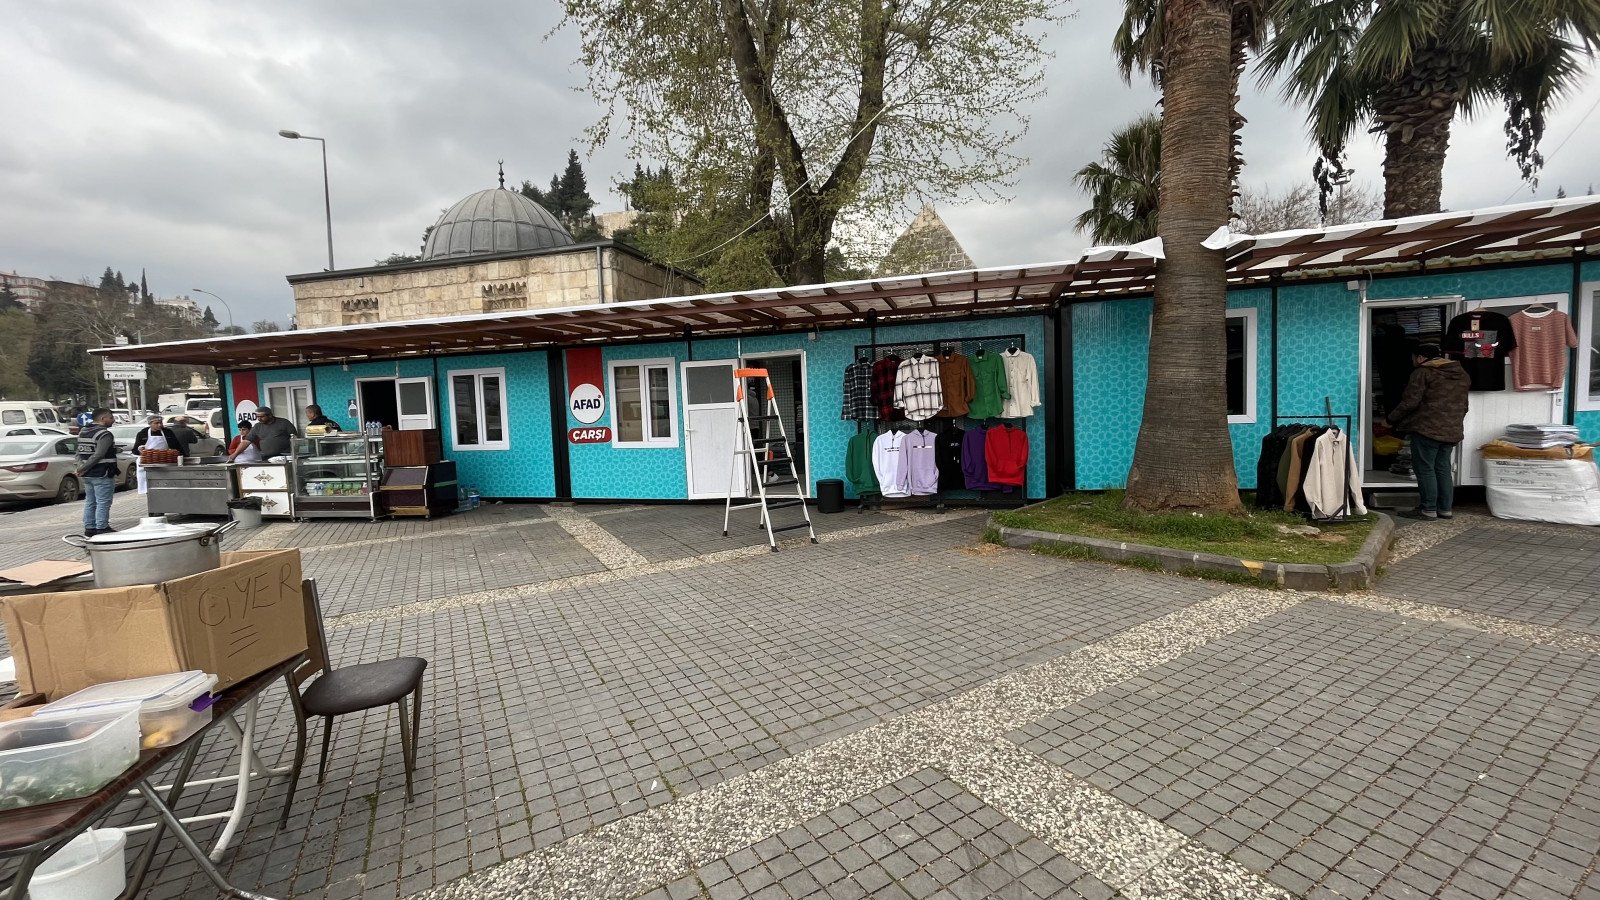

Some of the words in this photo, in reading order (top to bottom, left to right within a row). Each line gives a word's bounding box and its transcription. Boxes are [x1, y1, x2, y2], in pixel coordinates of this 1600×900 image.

[573, 399, 601, 410] AFAD
[238, 412, 257, 421] AFAD
[572, 429, 606, 441] ÇARŞI
